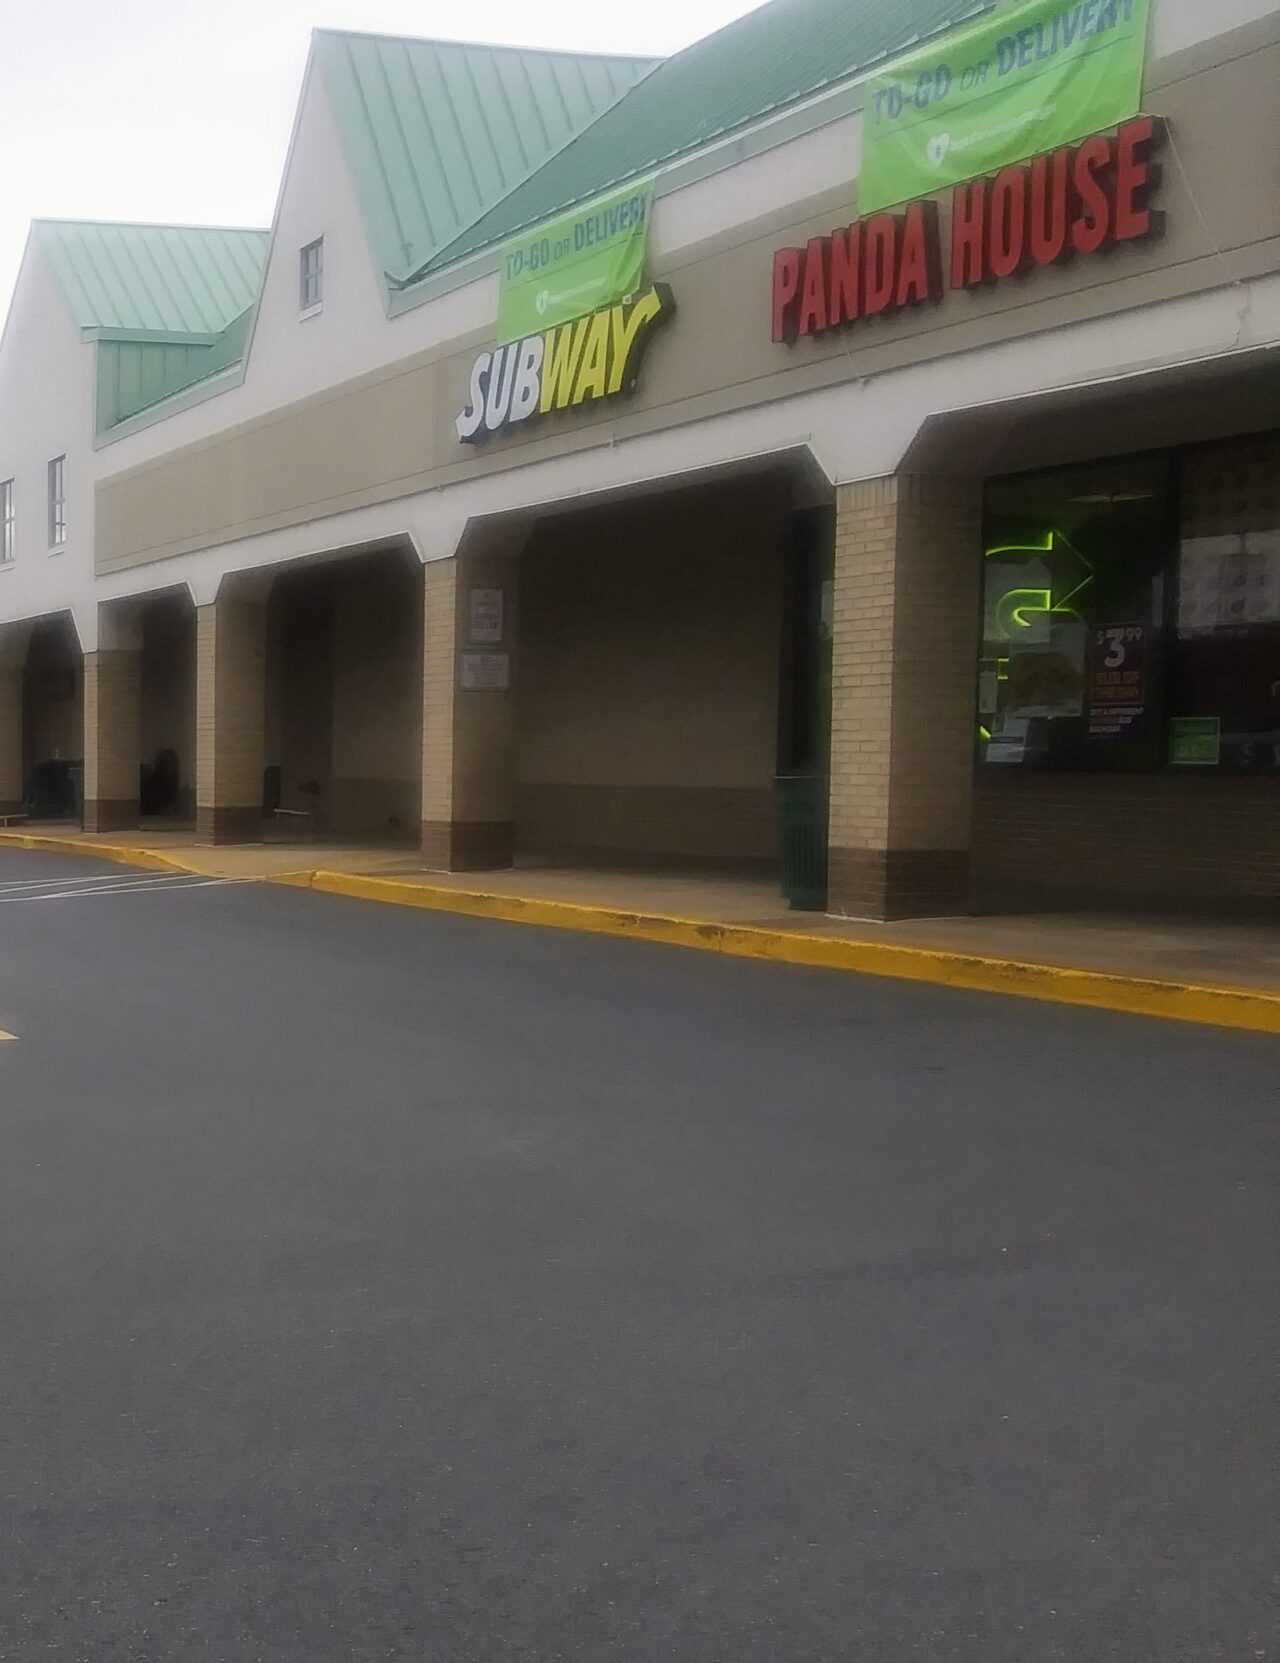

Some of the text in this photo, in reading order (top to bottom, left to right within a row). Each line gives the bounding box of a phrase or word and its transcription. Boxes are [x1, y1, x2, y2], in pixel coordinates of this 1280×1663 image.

[872, 64, 951, 125] TO-GO
[960, 60, 989, 92] OR
[505, 237, 550, 281] TO-GO
[554, 237, 571, 262] OR
[771, 116, 1157, 343] PANDA HOUSE
[455, 284, 663, 442] SUBWAY
